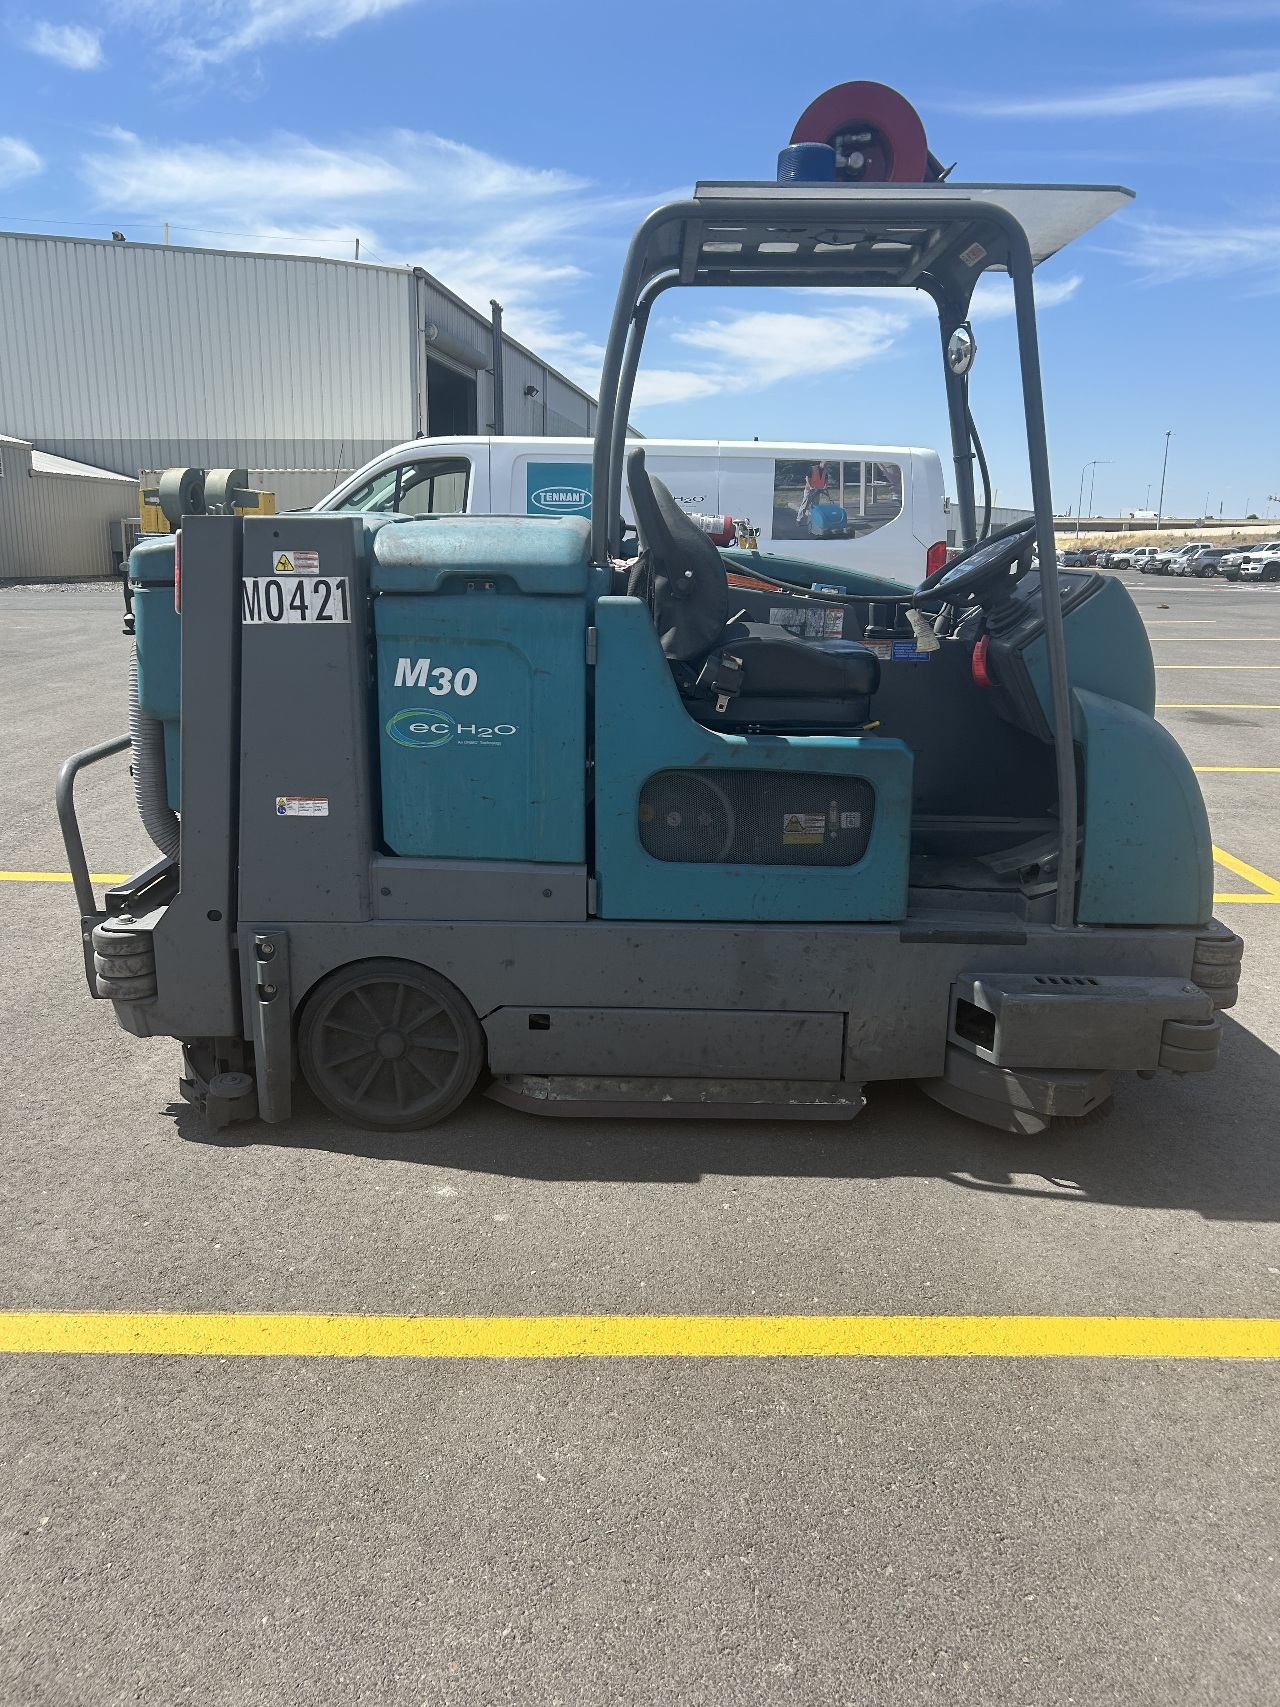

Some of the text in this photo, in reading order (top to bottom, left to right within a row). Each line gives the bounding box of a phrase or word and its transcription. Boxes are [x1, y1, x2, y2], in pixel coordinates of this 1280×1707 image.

[540, 492, 586, 505] TENNANT
[242, 579, 349, 621] M0421
[394, 657, 478, 696] M30
